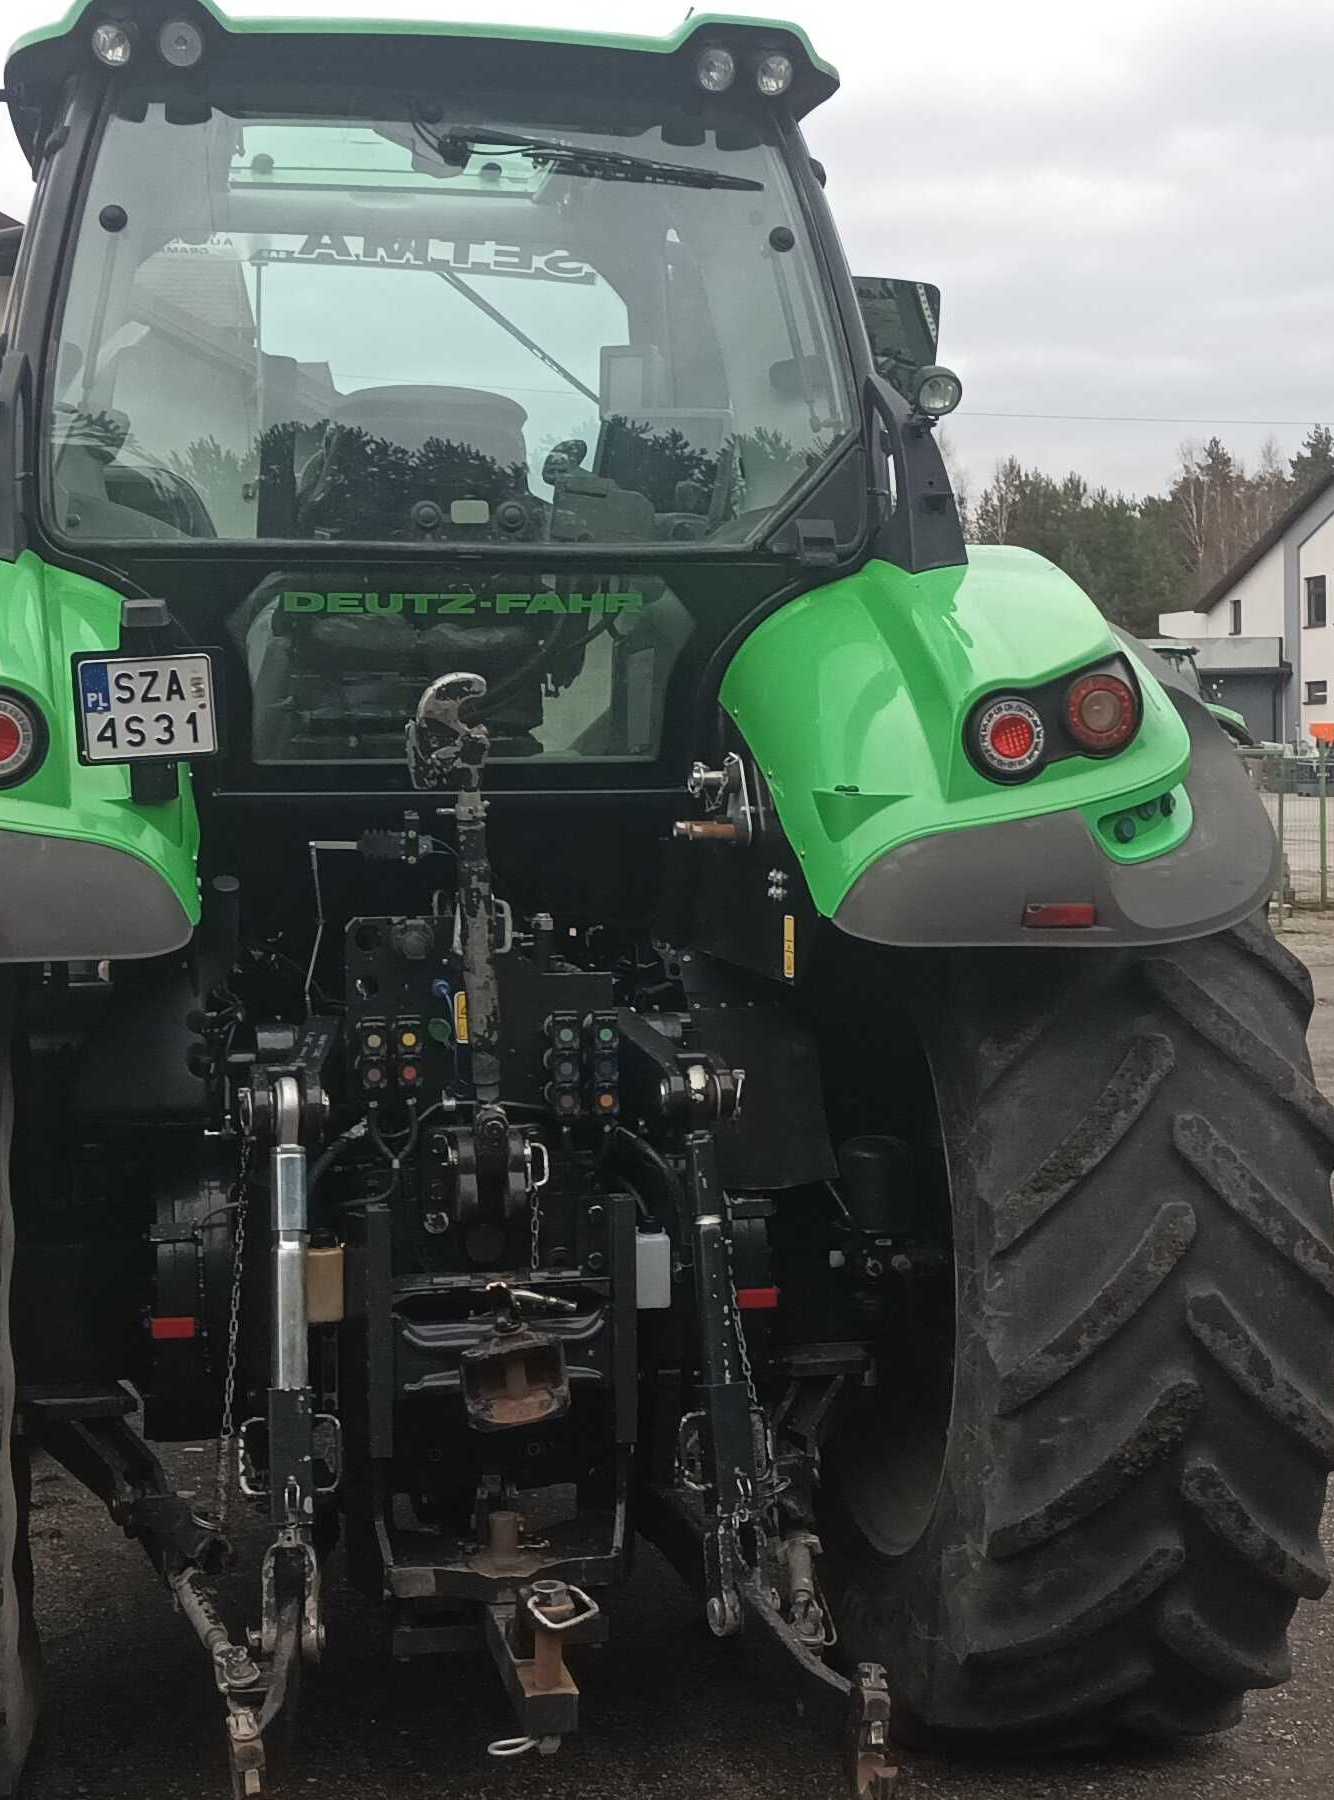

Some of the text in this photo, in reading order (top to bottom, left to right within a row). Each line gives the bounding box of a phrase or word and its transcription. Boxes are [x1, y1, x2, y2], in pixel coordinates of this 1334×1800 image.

[283, 591, 643, 616] DEUTZ-FAHR
[86, 692, 109, 708] PL
[114, 669, 186, 704] SZA
[96, 711, 200, 749] 4S31
